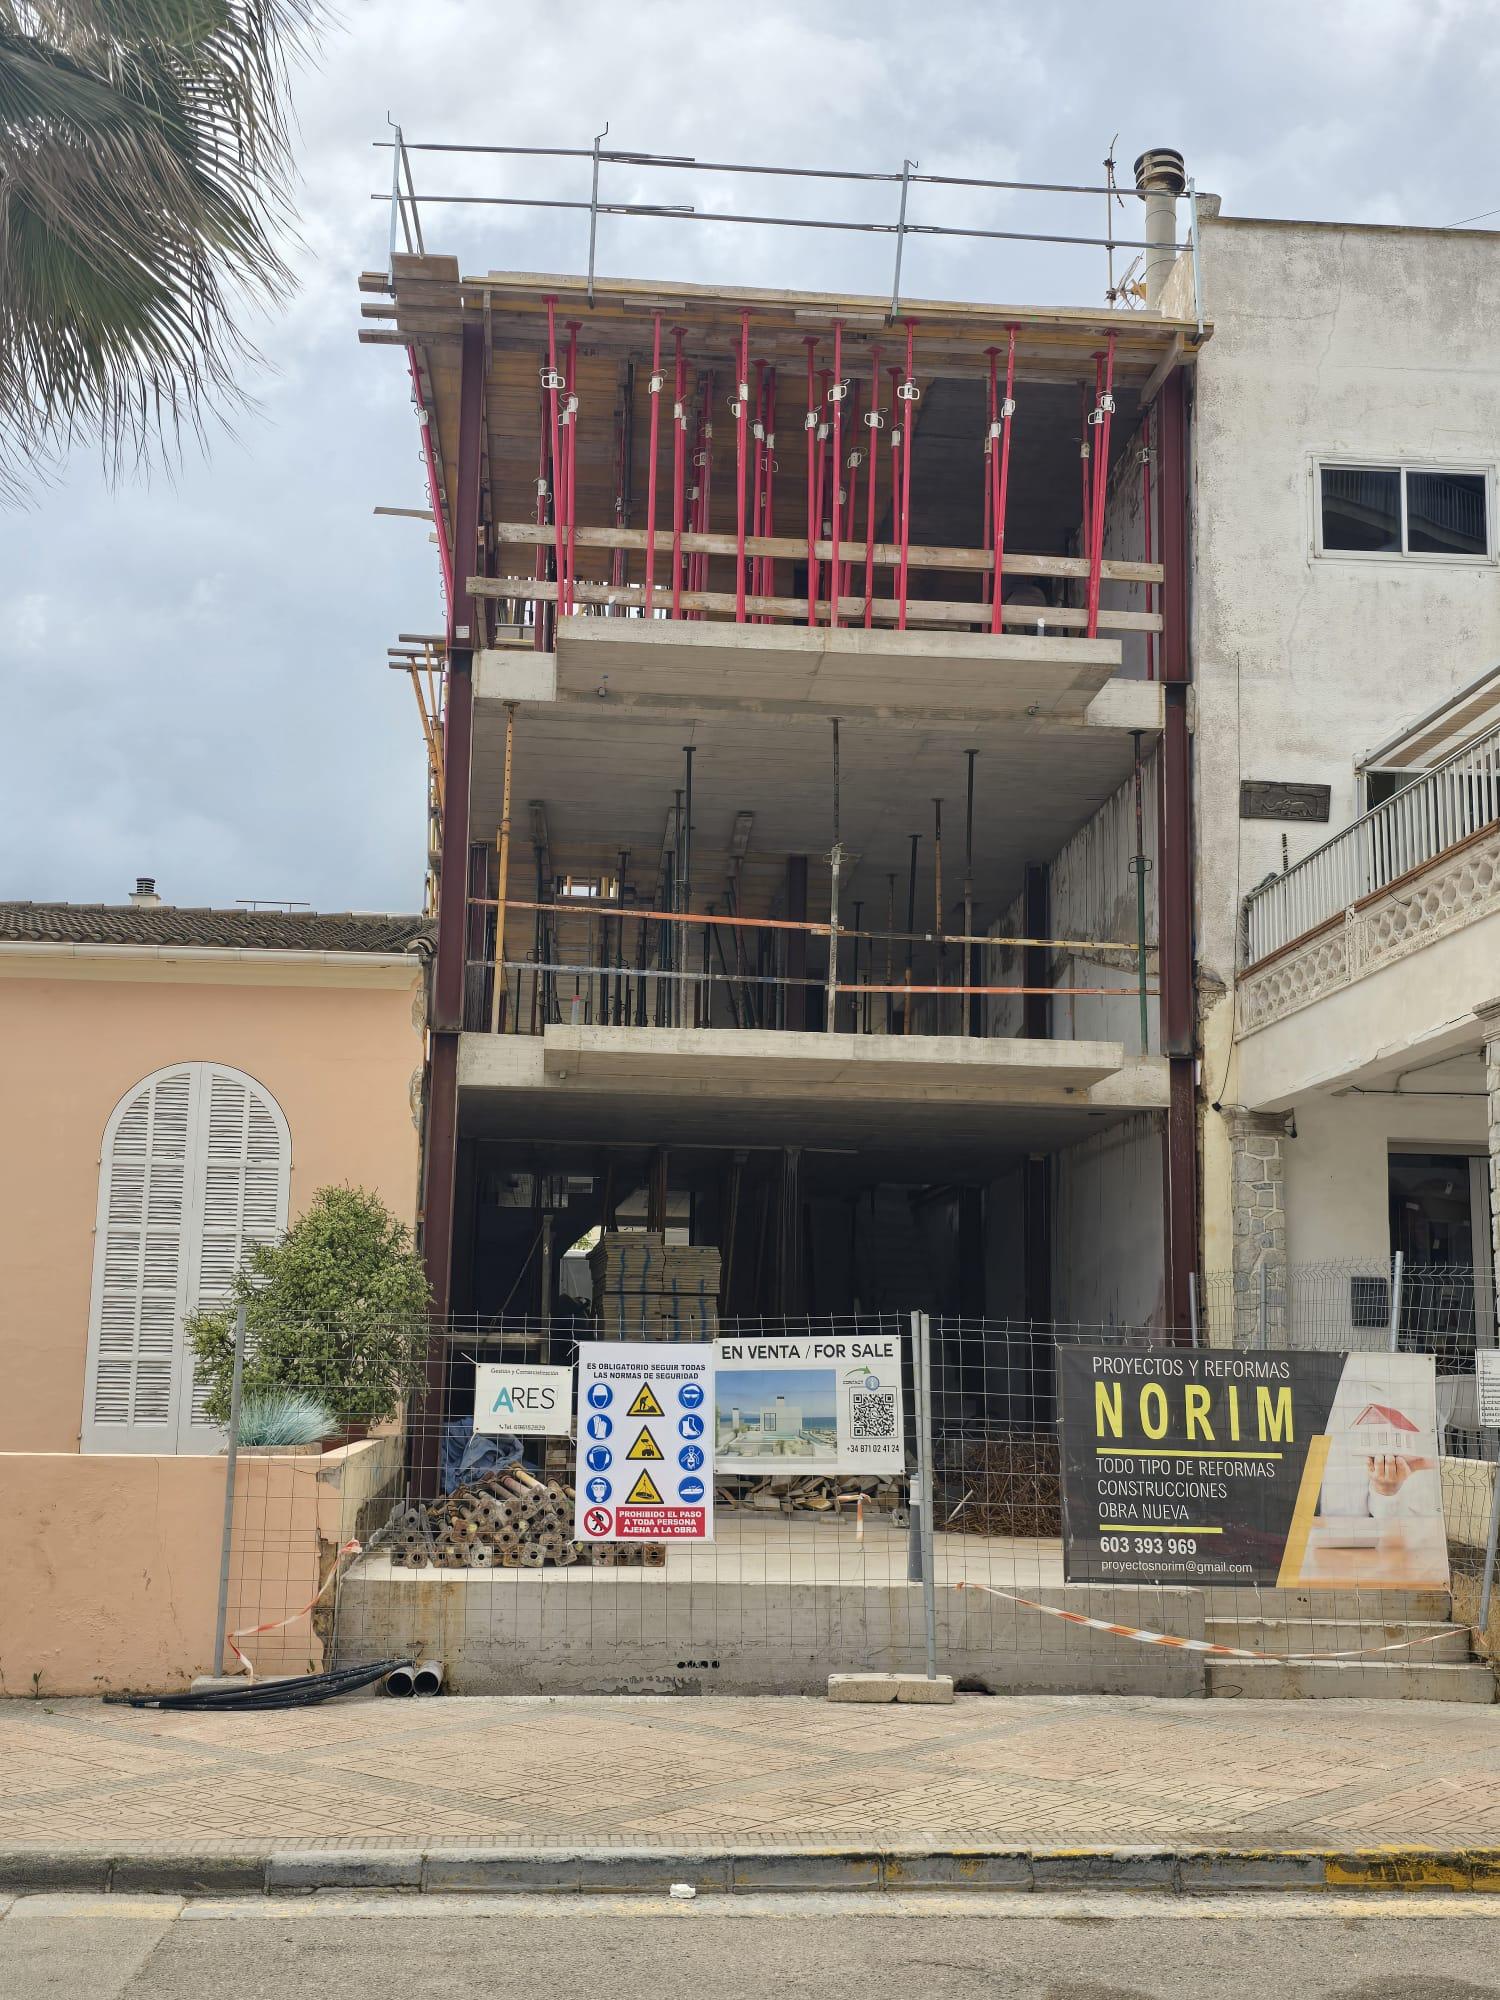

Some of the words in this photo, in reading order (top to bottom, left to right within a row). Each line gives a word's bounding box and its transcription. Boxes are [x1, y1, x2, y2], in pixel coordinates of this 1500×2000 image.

[722, 1345, 743, 1360] EN
[748, 1345, 800, 1359] VENTA
[814, 1344, 846, 1359] FOR
[851, 1343, 894, 1358] SALE
[598, 1363, 648, 1371] OBLIGATORIO
[655, 1372, 699, 1380] SEGURIDAD
[1092, 1356, 1184, 1376] PROYECTOS
[1188, 1360, 1199, 1377] Y
[1204, 1360, 1290, 1379] REFORMAS
[492, 1387, 555, 1413] ARES
[1095, 1381, 1294, 1443] NORIM
[847, 1445, 858, 1453] +34
[872, 1445, 881, 1453] 02
[882, 1445, 890, 1453] 41
[892, 1445, 900, 1453] 24
[1096, 1458, 1134, 1474] TODO
[1138, 1459, 1171, 1475] TIPO
[1176, 1460, 1194, 1476] DE
[1199, 1460, 1275, 1478] REFORMAS
[1098, 1480, 1227, 1499] CONSTRUCCIONES
[1098, 1502, 1138, 1519] OBRA
[1143, 1503, 1190, 1520] NUEVA
[1100, 1536, 1130, 1553] 603
[1134, 1538, 1163, 1554] 393
[1168, 1538, 1197, 1555] 969
[1101, 1560, 1253, 1575] proyectosnorim@gmail.com
